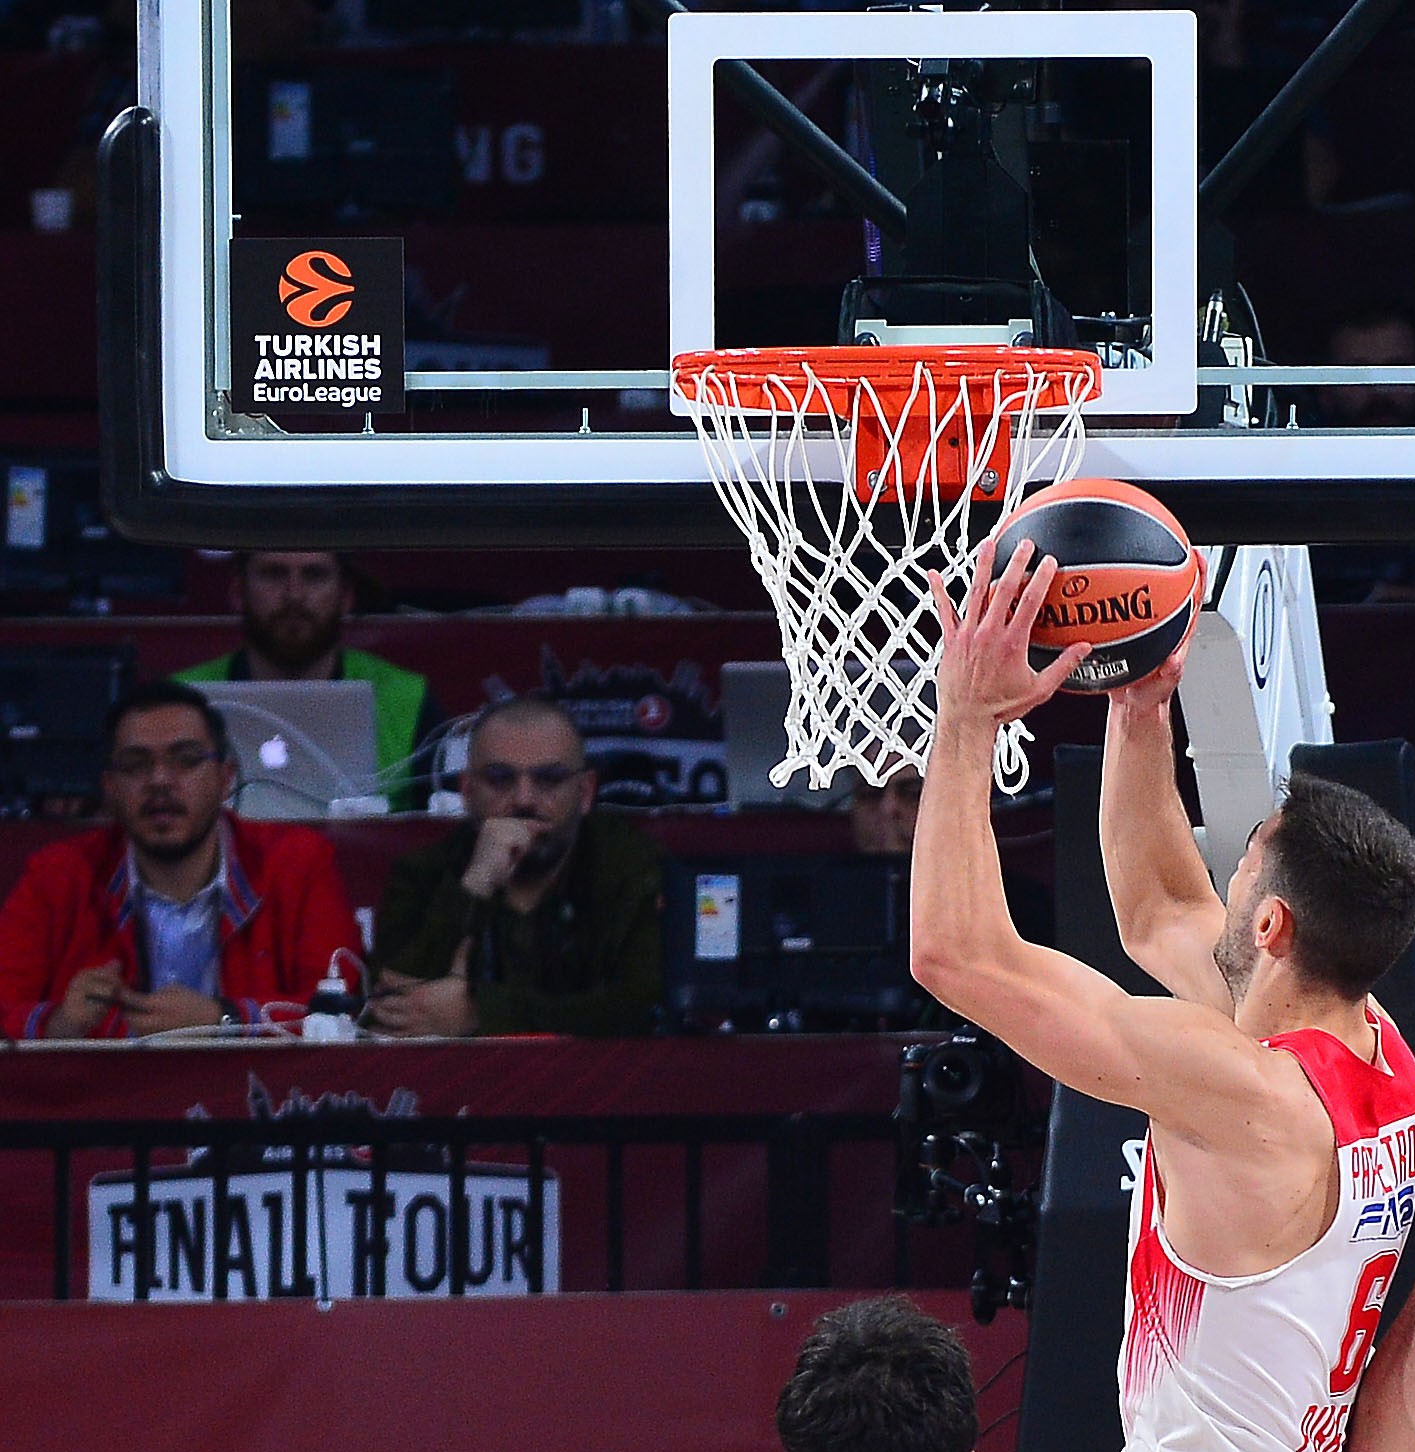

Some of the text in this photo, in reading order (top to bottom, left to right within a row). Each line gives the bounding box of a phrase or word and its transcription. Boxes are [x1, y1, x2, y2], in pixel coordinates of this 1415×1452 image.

[253, 334, 382, 357] TURKISH
[253, 358, 383, 380] AIRLINES
[253, 382, 382, 408] EuroLeague
[1330, 1249, 1400, 1397] 6
